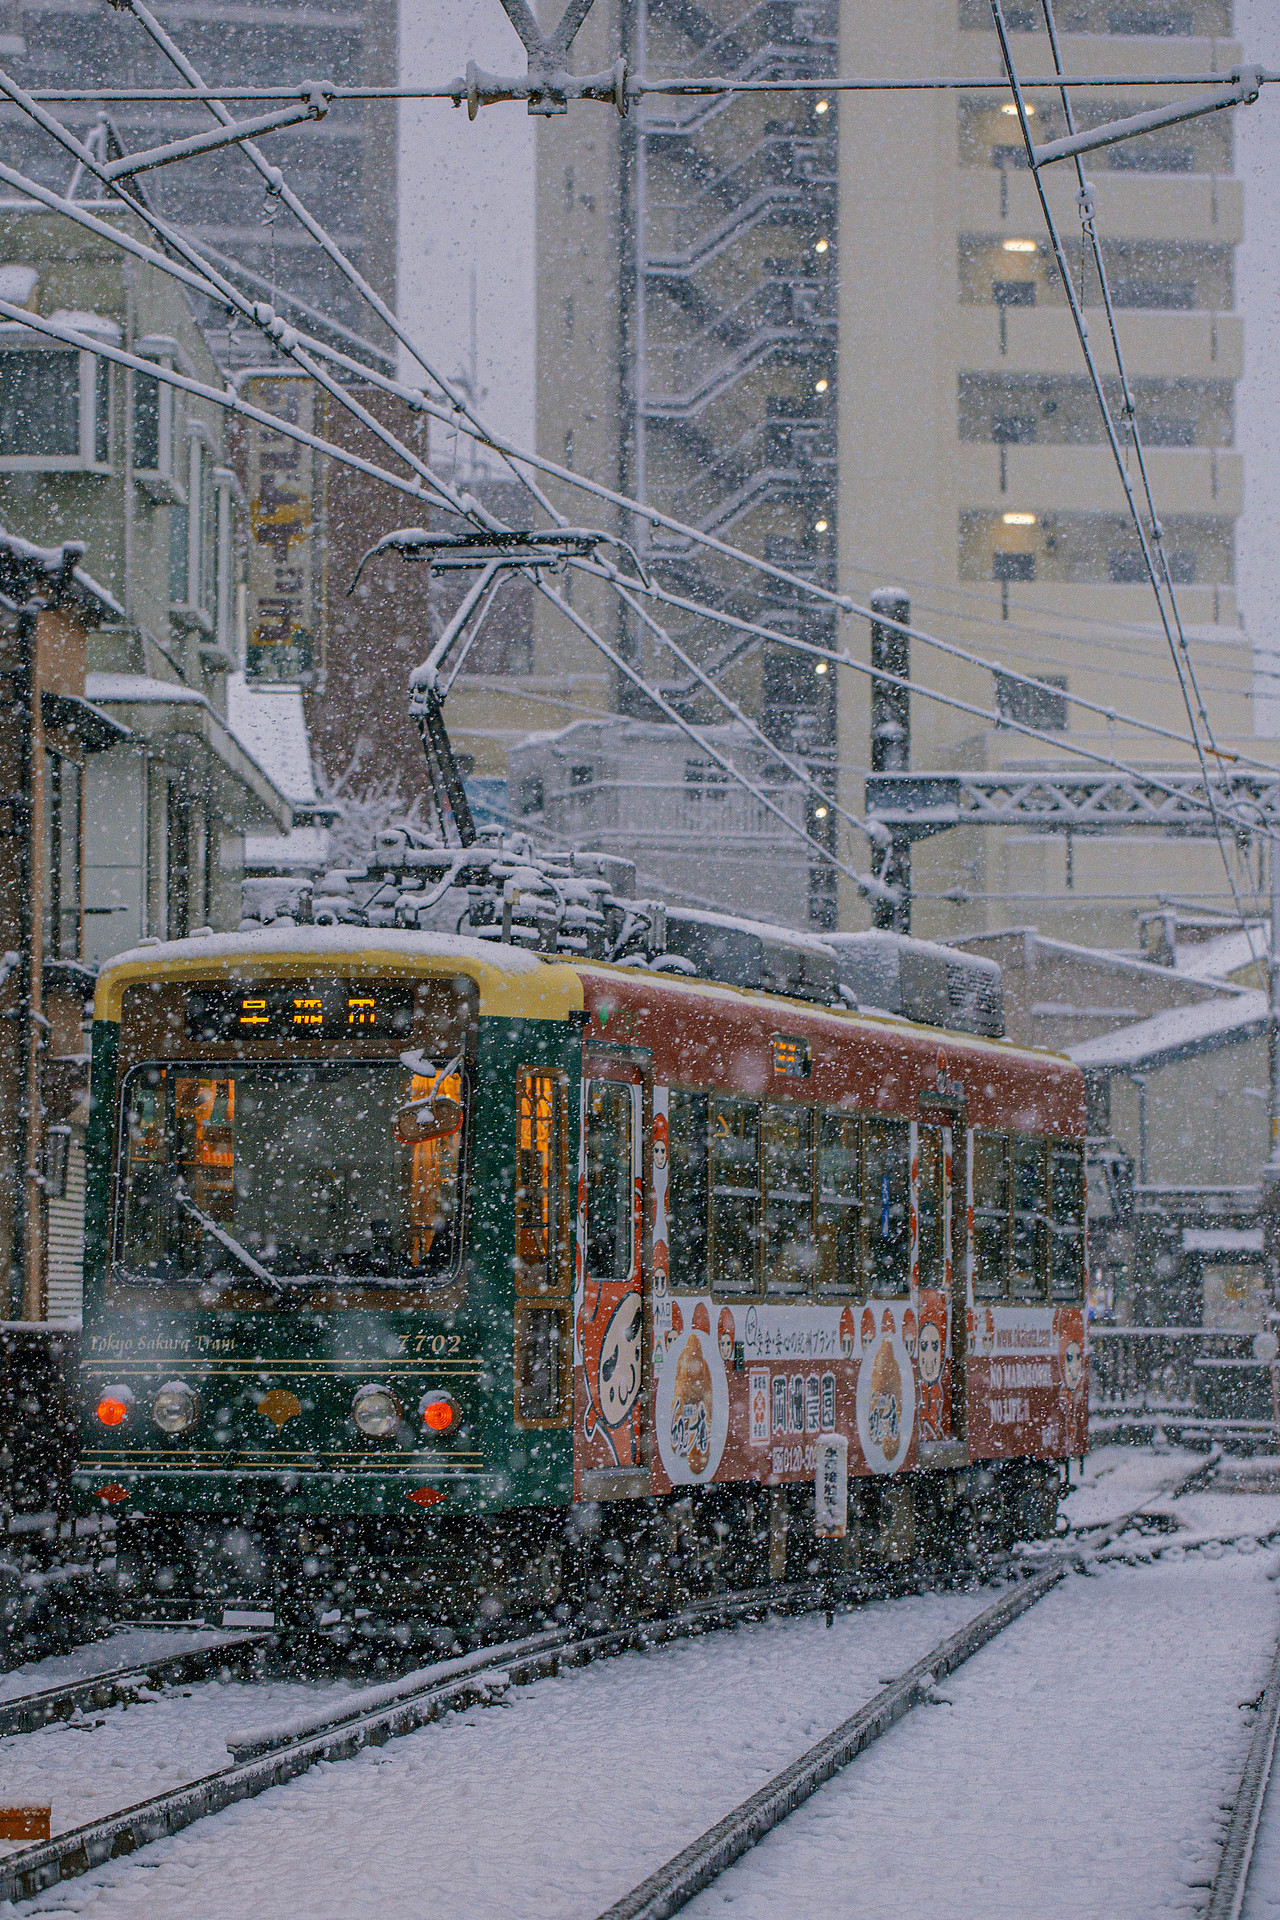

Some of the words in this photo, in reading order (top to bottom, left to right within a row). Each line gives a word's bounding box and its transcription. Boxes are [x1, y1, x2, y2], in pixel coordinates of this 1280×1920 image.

[89, 1332, 133, 1353] Tokyo
[137, 1332, 191, 1351] Sakura
[195, 1334, 236, 1351] Tram
[397, 1334, 461, 1353] 7702
